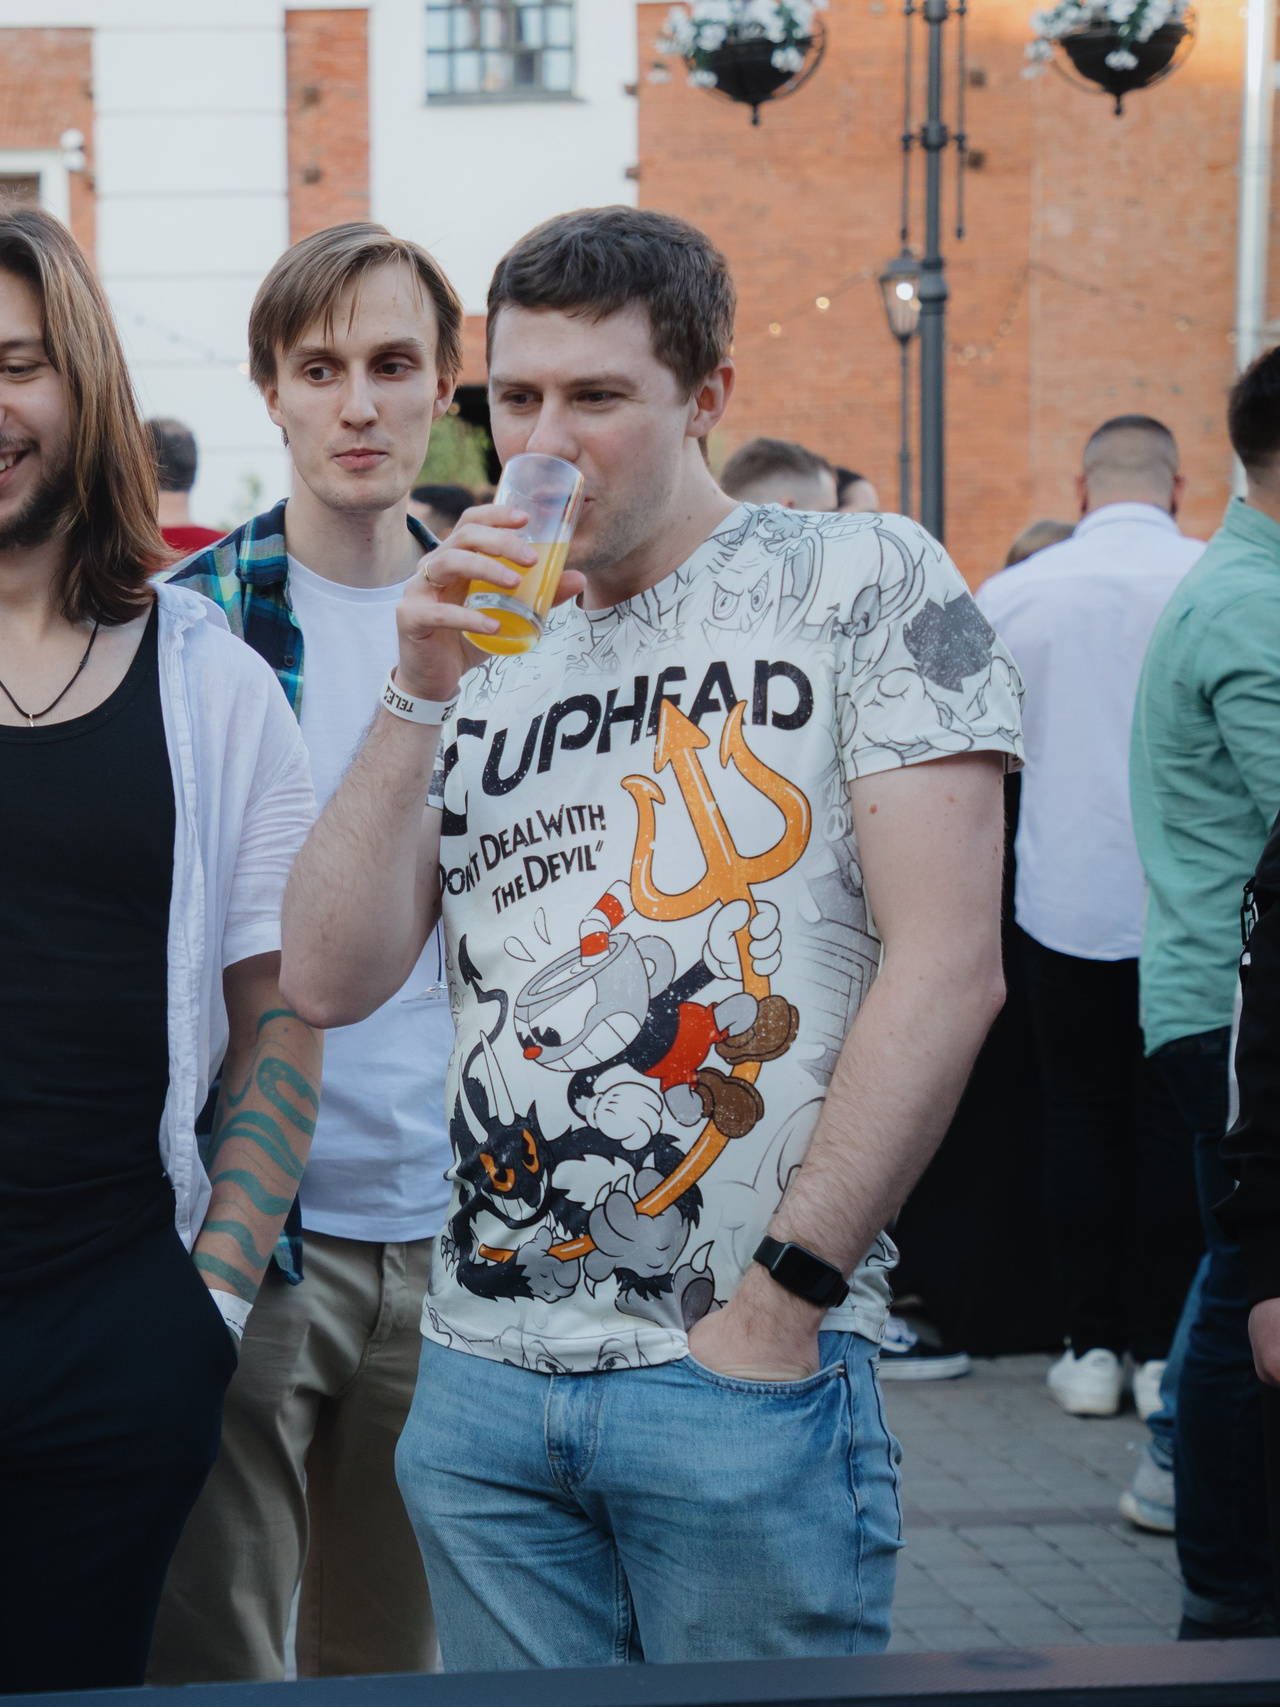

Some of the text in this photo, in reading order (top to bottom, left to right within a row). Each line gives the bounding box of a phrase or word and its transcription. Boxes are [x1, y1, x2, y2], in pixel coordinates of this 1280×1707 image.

[479, 822, 543, 872] DEAL
[535, 804, 607, 840] WITH
[492, 874, 527, 914] THE
